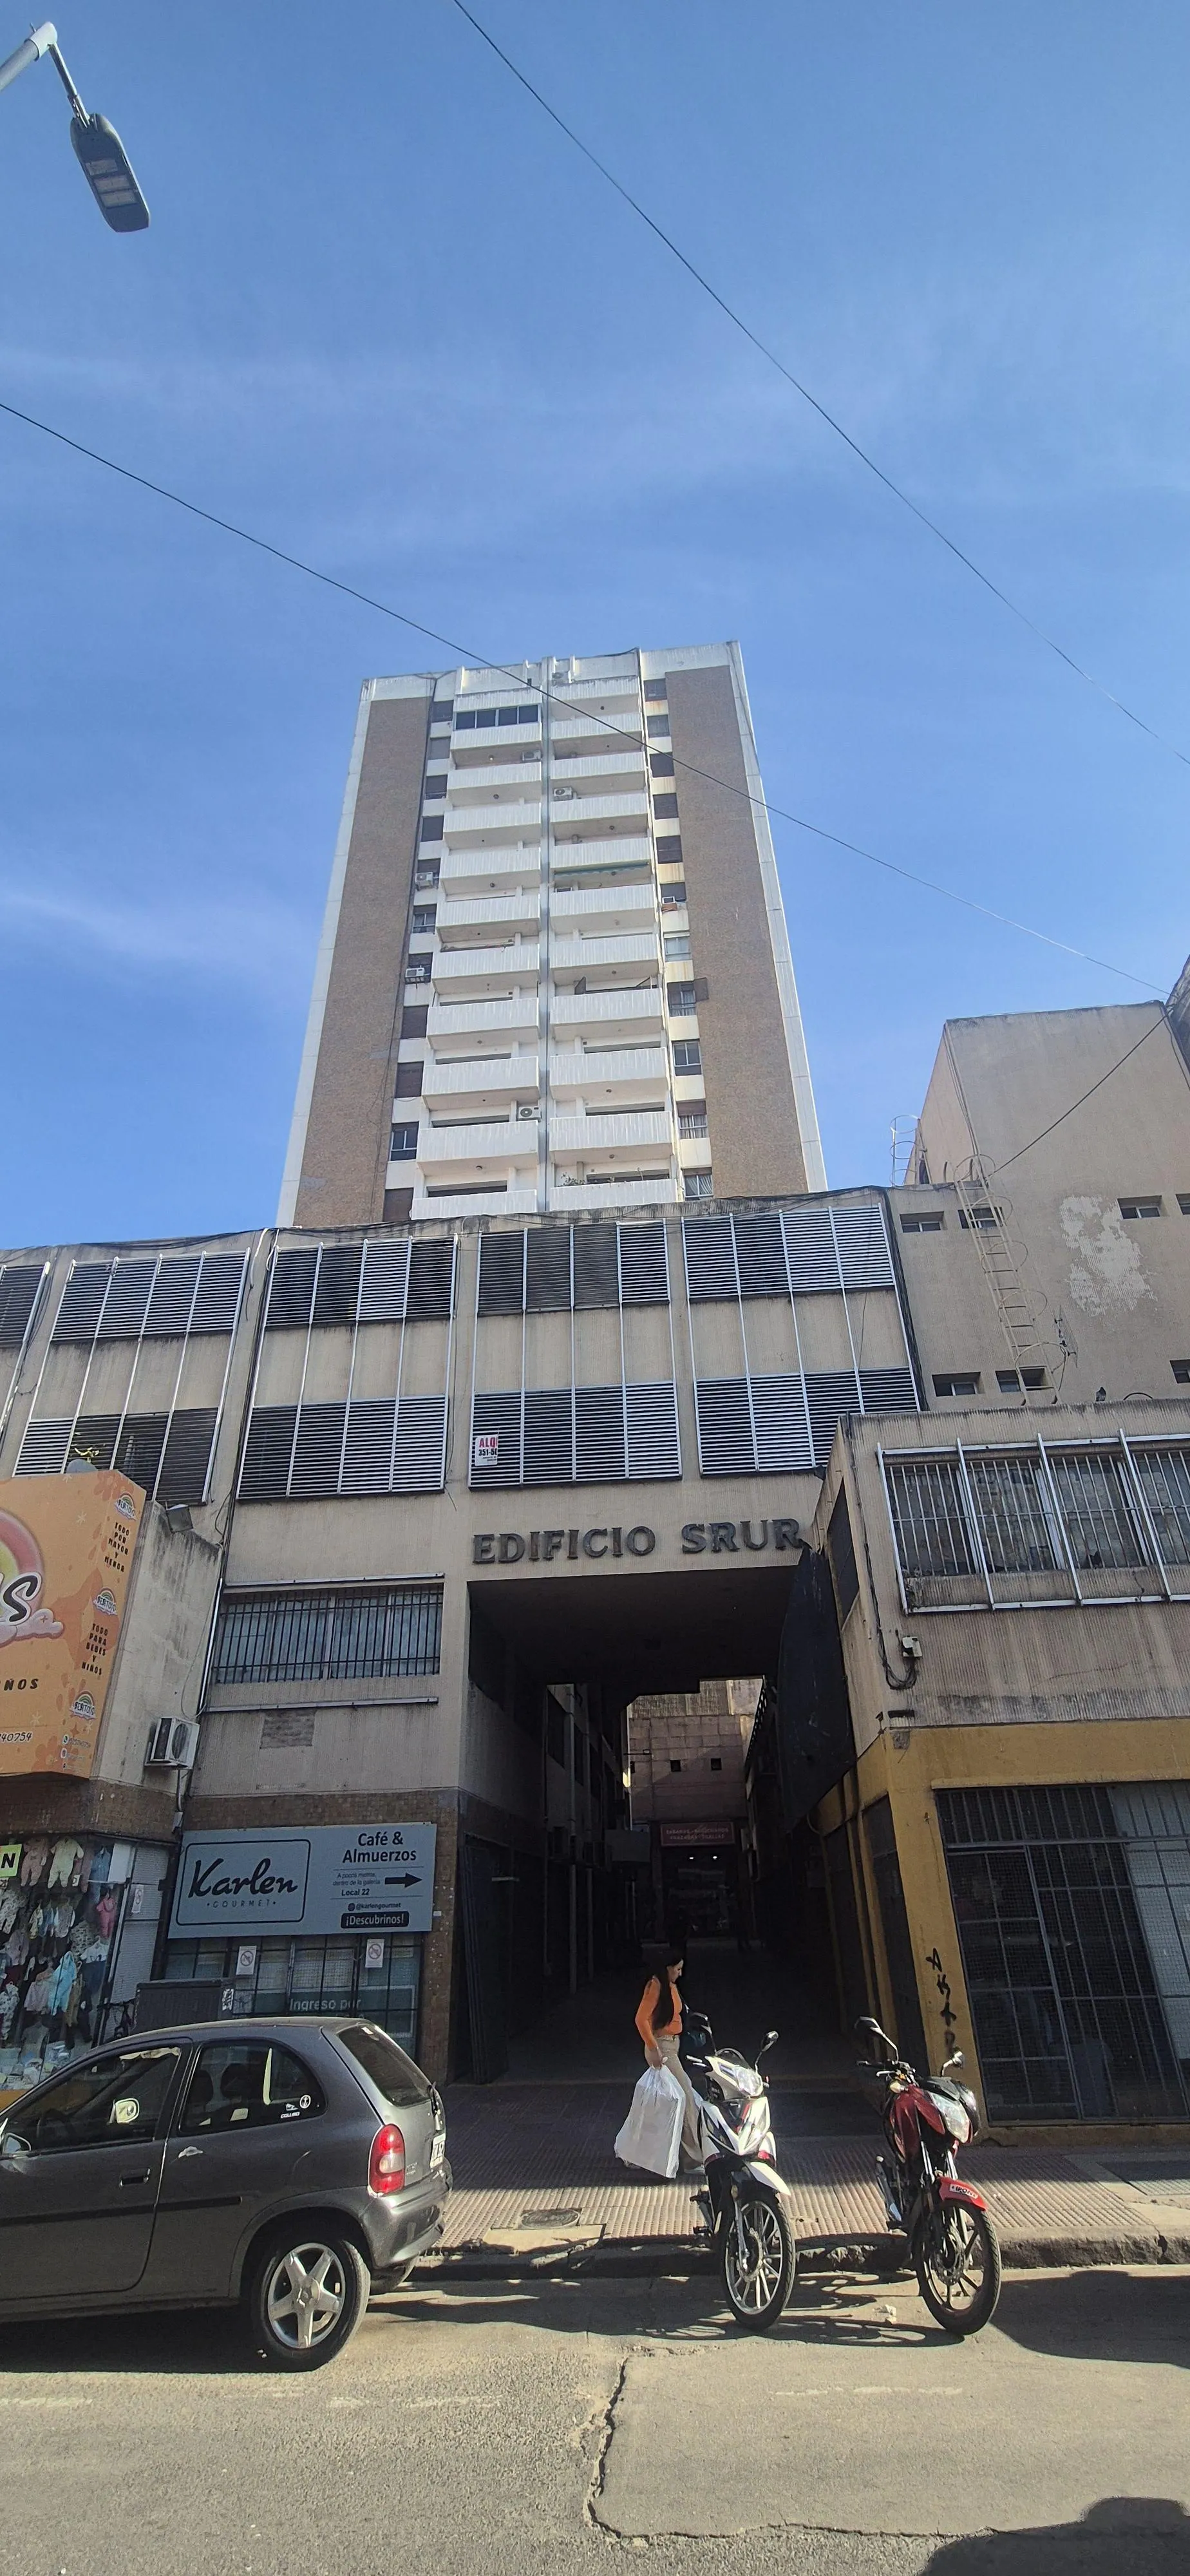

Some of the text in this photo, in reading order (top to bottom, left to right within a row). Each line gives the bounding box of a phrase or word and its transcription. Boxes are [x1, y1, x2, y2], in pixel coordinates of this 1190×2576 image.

[115, 1522, 129, 1536] TODO
[114, 1532, 126, 1544] POR
[472, 1518, 802, 1564] EDIFICIO SRUR
[108, 1538, 129, 1555] MAYOR
[104, 1556, 125, 1572] MENOR
[92, 1624, 108, 1636] TODO
[89, 1633, 106, 1646] PARA
[0, 1732, 32, 1742] 40754
[358, 1831, 404, 1846] Café &
[342, 1848, 417, 1863] Almuerzos
[188, 1858, 298, 1898] Karlen
[212, 1899, 270, 1908] GOURMET
[346, 1913, 404, 1927] ¡Descubrinos!
[290, 1998, 336, 2012] Ingreso
